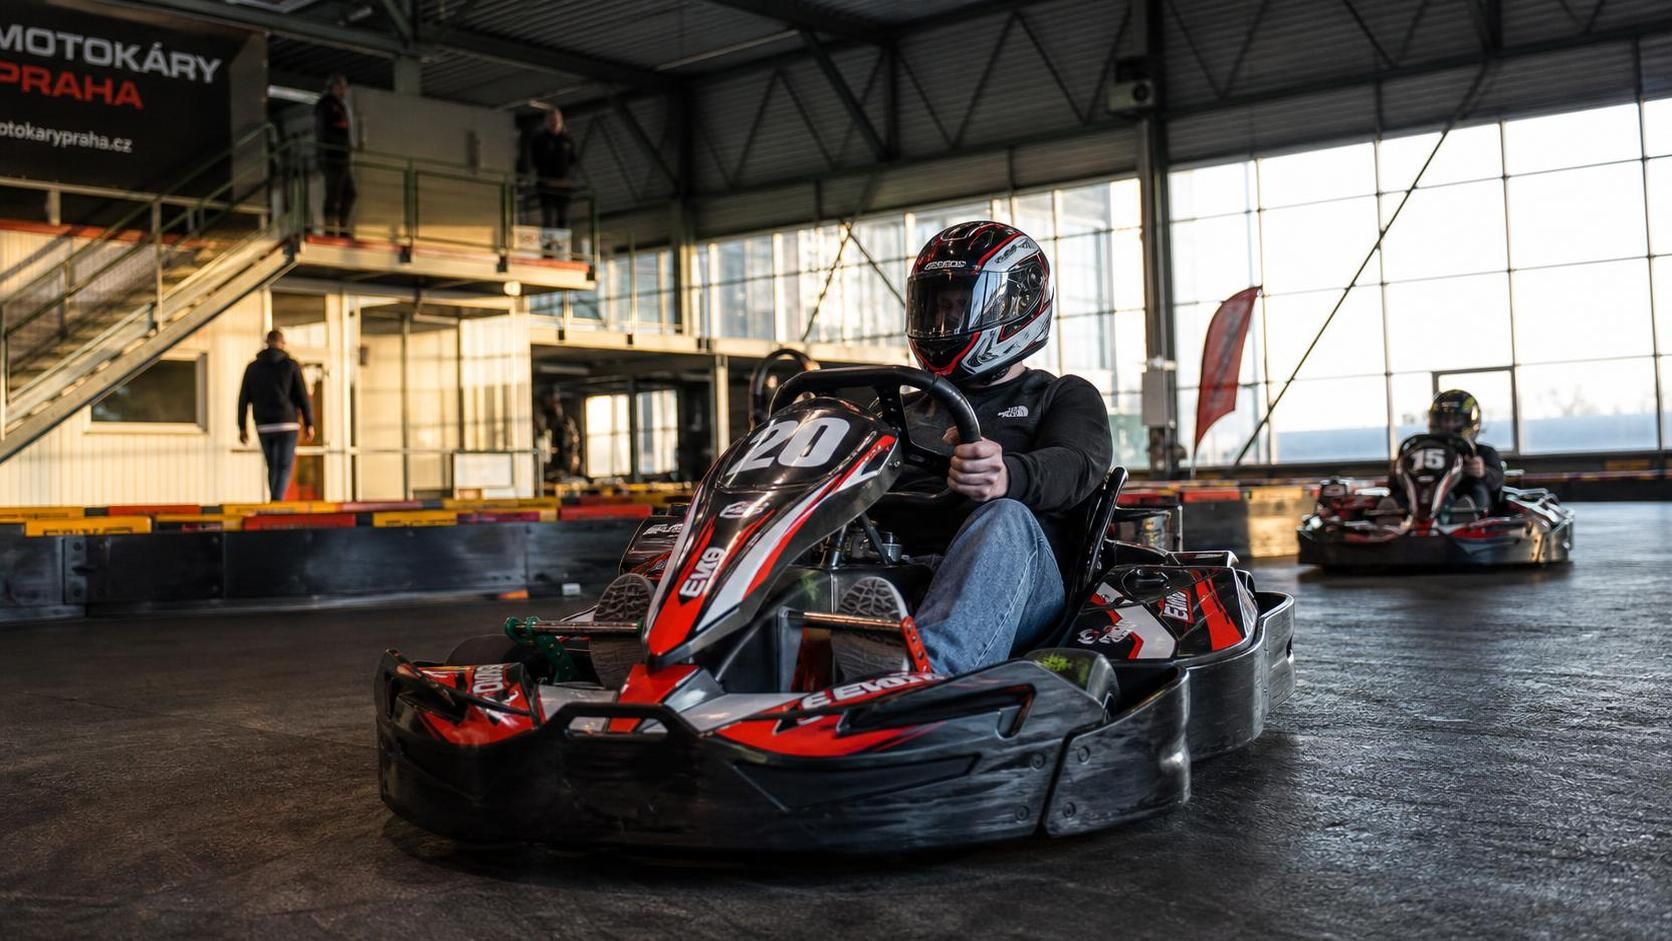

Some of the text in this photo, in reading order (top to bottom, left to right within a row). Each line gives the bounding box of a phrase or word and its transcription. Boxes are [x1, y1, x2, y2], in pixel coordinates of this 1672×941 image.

[0, 24, 221, 83] MOTOKÁRY
[0, 60, 144, 110] PRAHA
[725, 417, 850, 475] 20
[1410, 448, 1446, 470] 15
